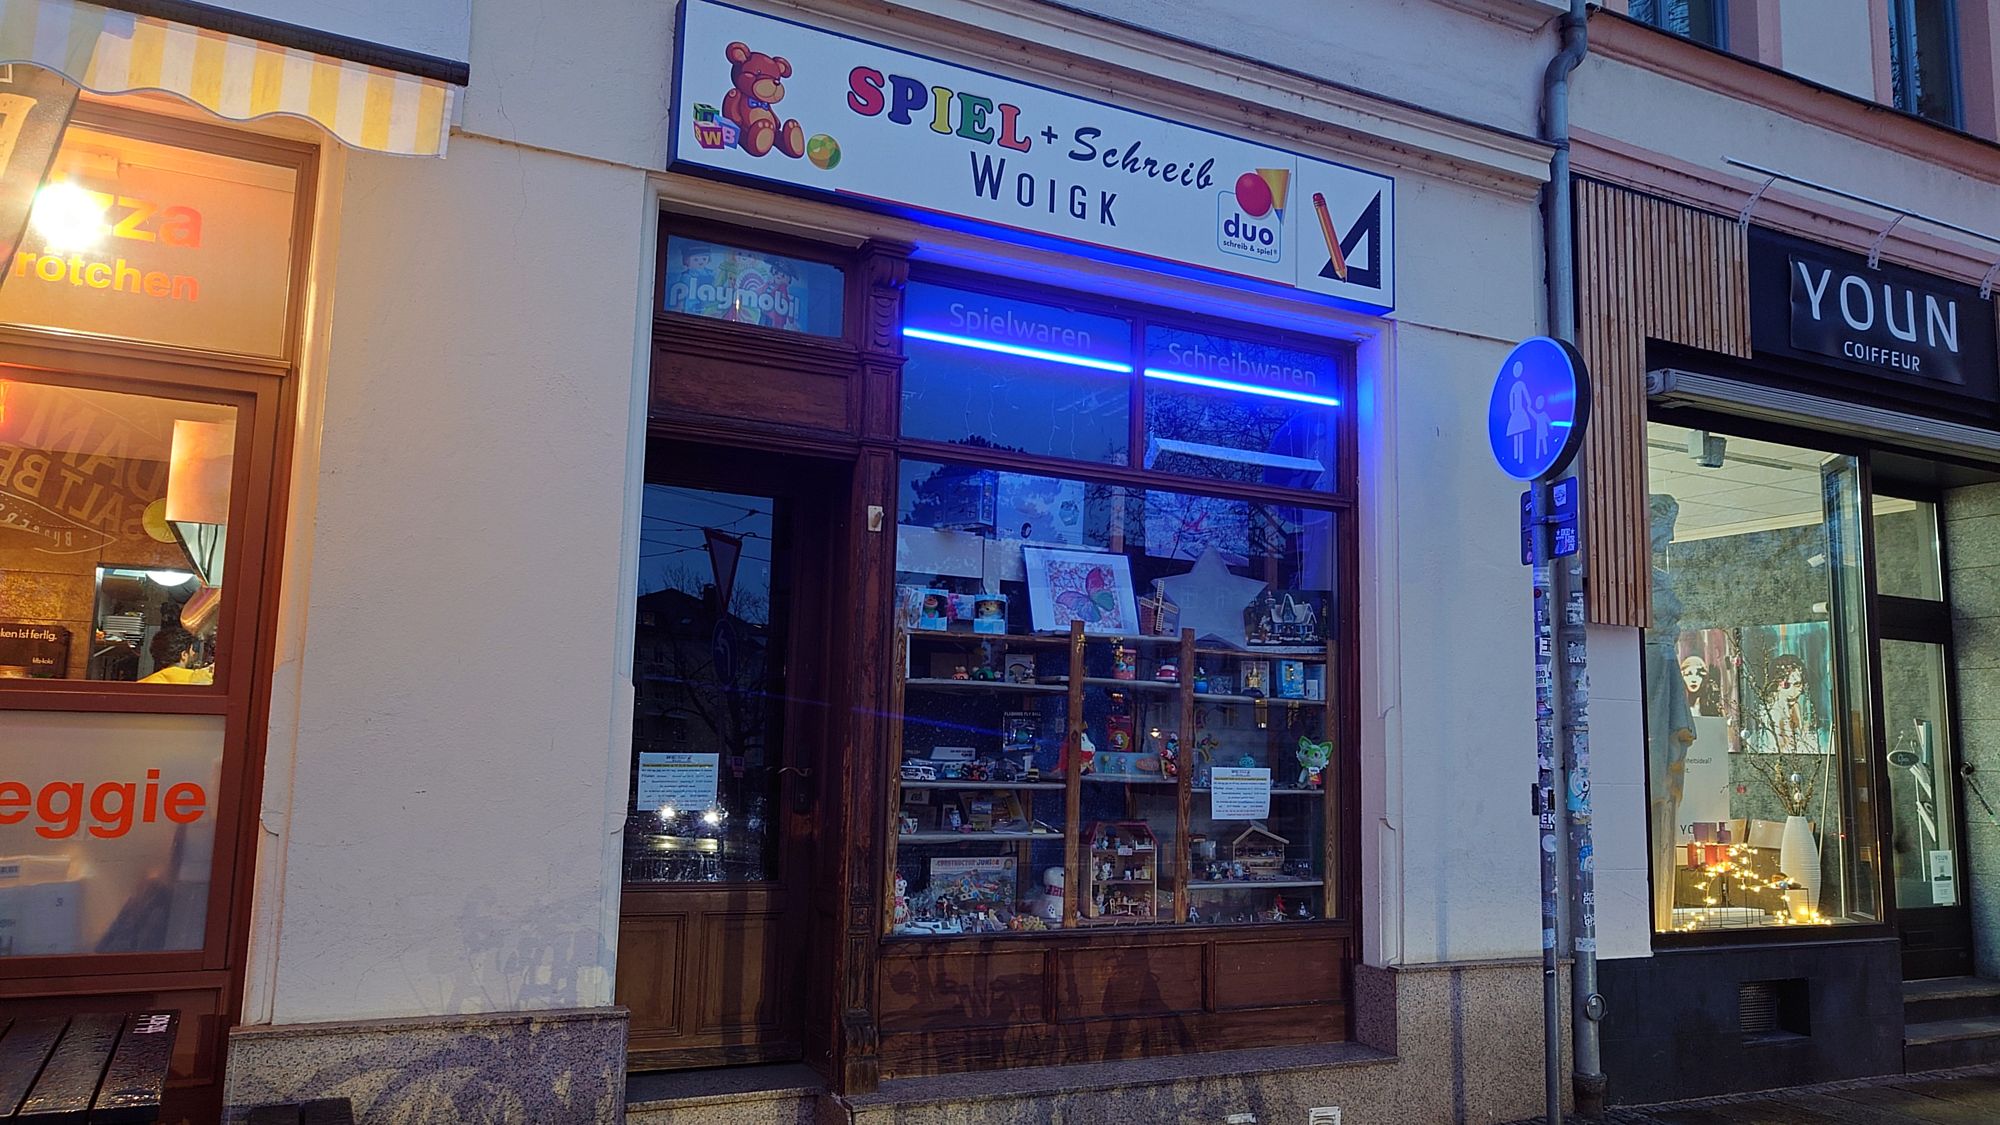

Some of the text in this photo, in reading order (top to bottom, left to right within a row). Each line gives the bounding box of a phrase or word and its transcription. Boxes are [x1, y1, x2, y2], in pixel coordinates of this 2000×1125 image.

[847, 66, 1215, 189] SPIEL + Schreib
[970, 151, 1117, 226] WOIGK
[1223, 240, 1248, 251] schreib
[1224, 213, 1274, 245] duo
[670, 277, 800, 320] playmobil
[1798, 262, 1959, 353] YOUN
[949, 303, 1092, 350] Spielwaren
[1168, 341, 1317, 388] Schreibwaren
[1844, 341, 1921, 372] COIFFEUR
[0, 769, 206, 839] eggie
